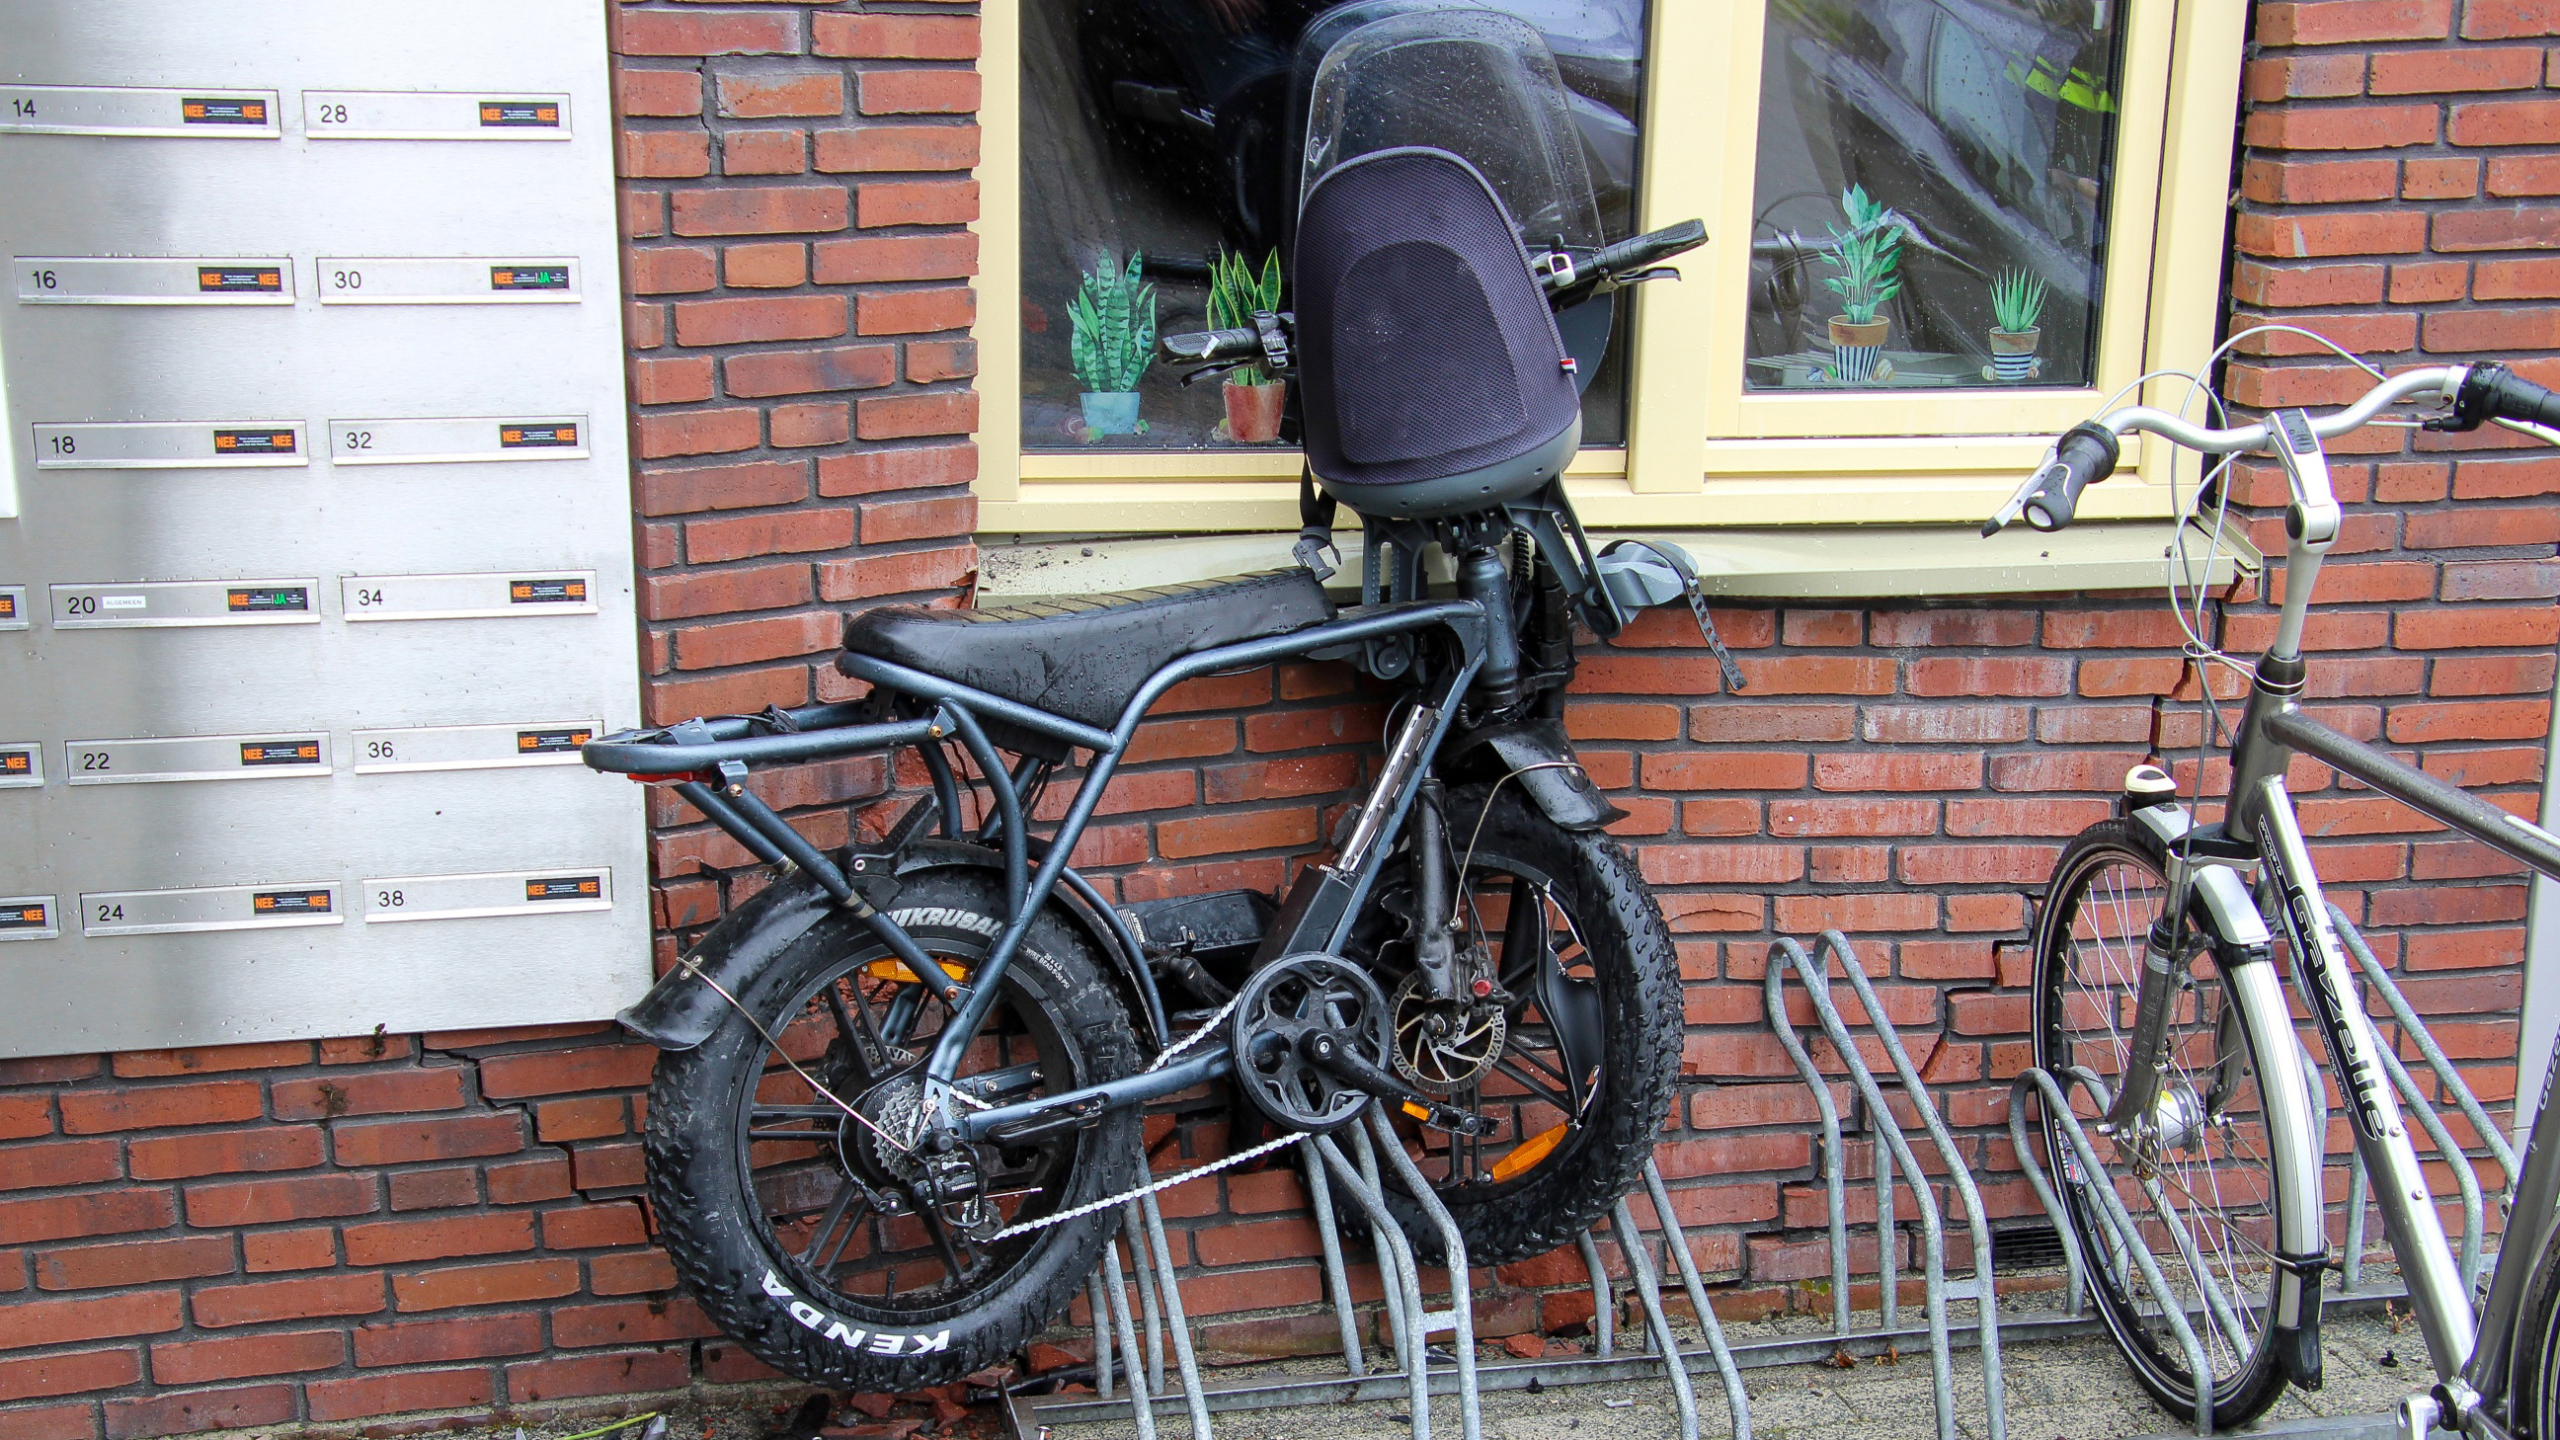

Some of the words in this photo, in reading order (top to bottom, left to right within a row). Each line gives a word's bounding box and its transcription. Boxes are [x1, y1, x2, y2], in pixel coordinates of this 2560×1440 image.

[13, 99, 36, 117] 14
[184, 105, 205, 118] NEE
[242, 106, 263, 118] NEE
[321, 106, 347, 122] 28
[481, 109, 501, 121] NEE
[537, 109, 557, 121] NEE
[33, 271, 56, 289] 16
[201, 273, 222, 286] NEE
[258, 274, 279, 286] NEE
[335, 272, 361, 288] 30
[494, 272, 513, 284] NEE
[538, 272, 550, 284] JA
[216, 435, 236, 447] NEE
[272, 435, 293, 447] NEE
[347, 432, 371, 448] 32
[502, 430, 522, 442] NEE
[555, 429, 575, 441] NEE
[52, 436, 75, 454] 18
[358, 589, 383, 606] 34
[512, 586, 532, 598] NEE
[565, 584, 585, 596] NEE
[0, 601, 12, 611] EE
[68, 597, 95, 614] 20
[228, 593, 248, 606] NEE
[274, 593, 287, 605] JA
[368, 741, 394, 758] 36
[519, 737, 538, 748] NEE
[243, 748, 263, 760] NEE
[298, 746, 318, 758] NEE
[6, 756, 27, 769] NEE
[84, 753, 110, 770] 22
[527, 884, 547, 896] NEE
[579, 881, 598, 893] NEE
[254, 897, 274, 909] NEE
[308, 895, 328, 907] NEE
[379, 890, 404, 907] 38
[24, 909, 43, 921] NEE
[98, 904, 124, 922] 24
[1044, 952, 1052, 961] 20
[1026, 947, 1041, 960] WIRE
[1038, 957, 1054, 971] BEAD
[1061, 979, 1071, 989] PSI
[2292, 893, 2387, 1141] Gazelle
[2539, 1026, 2560, 1111] Gaze
[761, 1268, 950, 1355] KENDA
